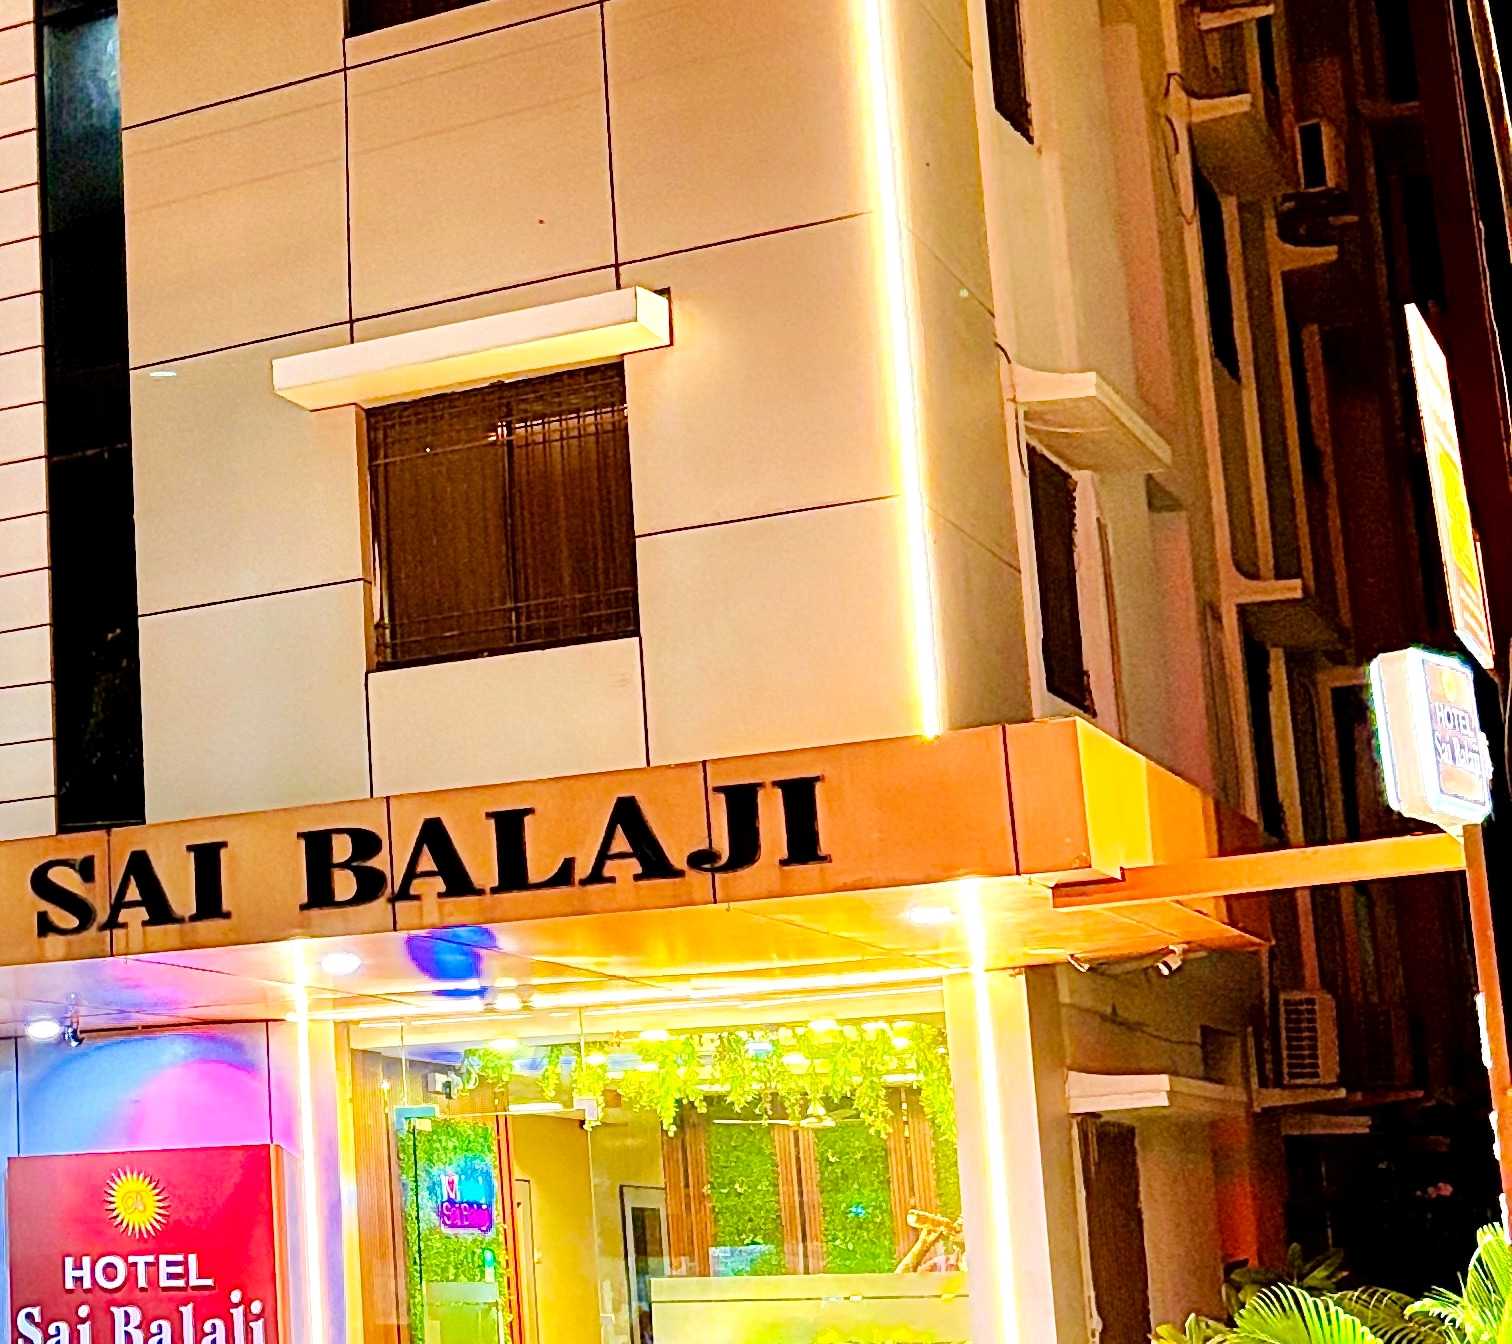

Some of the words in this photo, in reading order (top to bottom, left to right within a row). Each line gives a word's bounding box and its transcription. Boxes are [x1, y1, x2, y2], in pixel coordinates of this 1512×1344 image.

[30, 840, 232, 939] SAI
[296, 774, 833, 912] BALAJI
[64, 1253, 216, 1290] HOTEL
